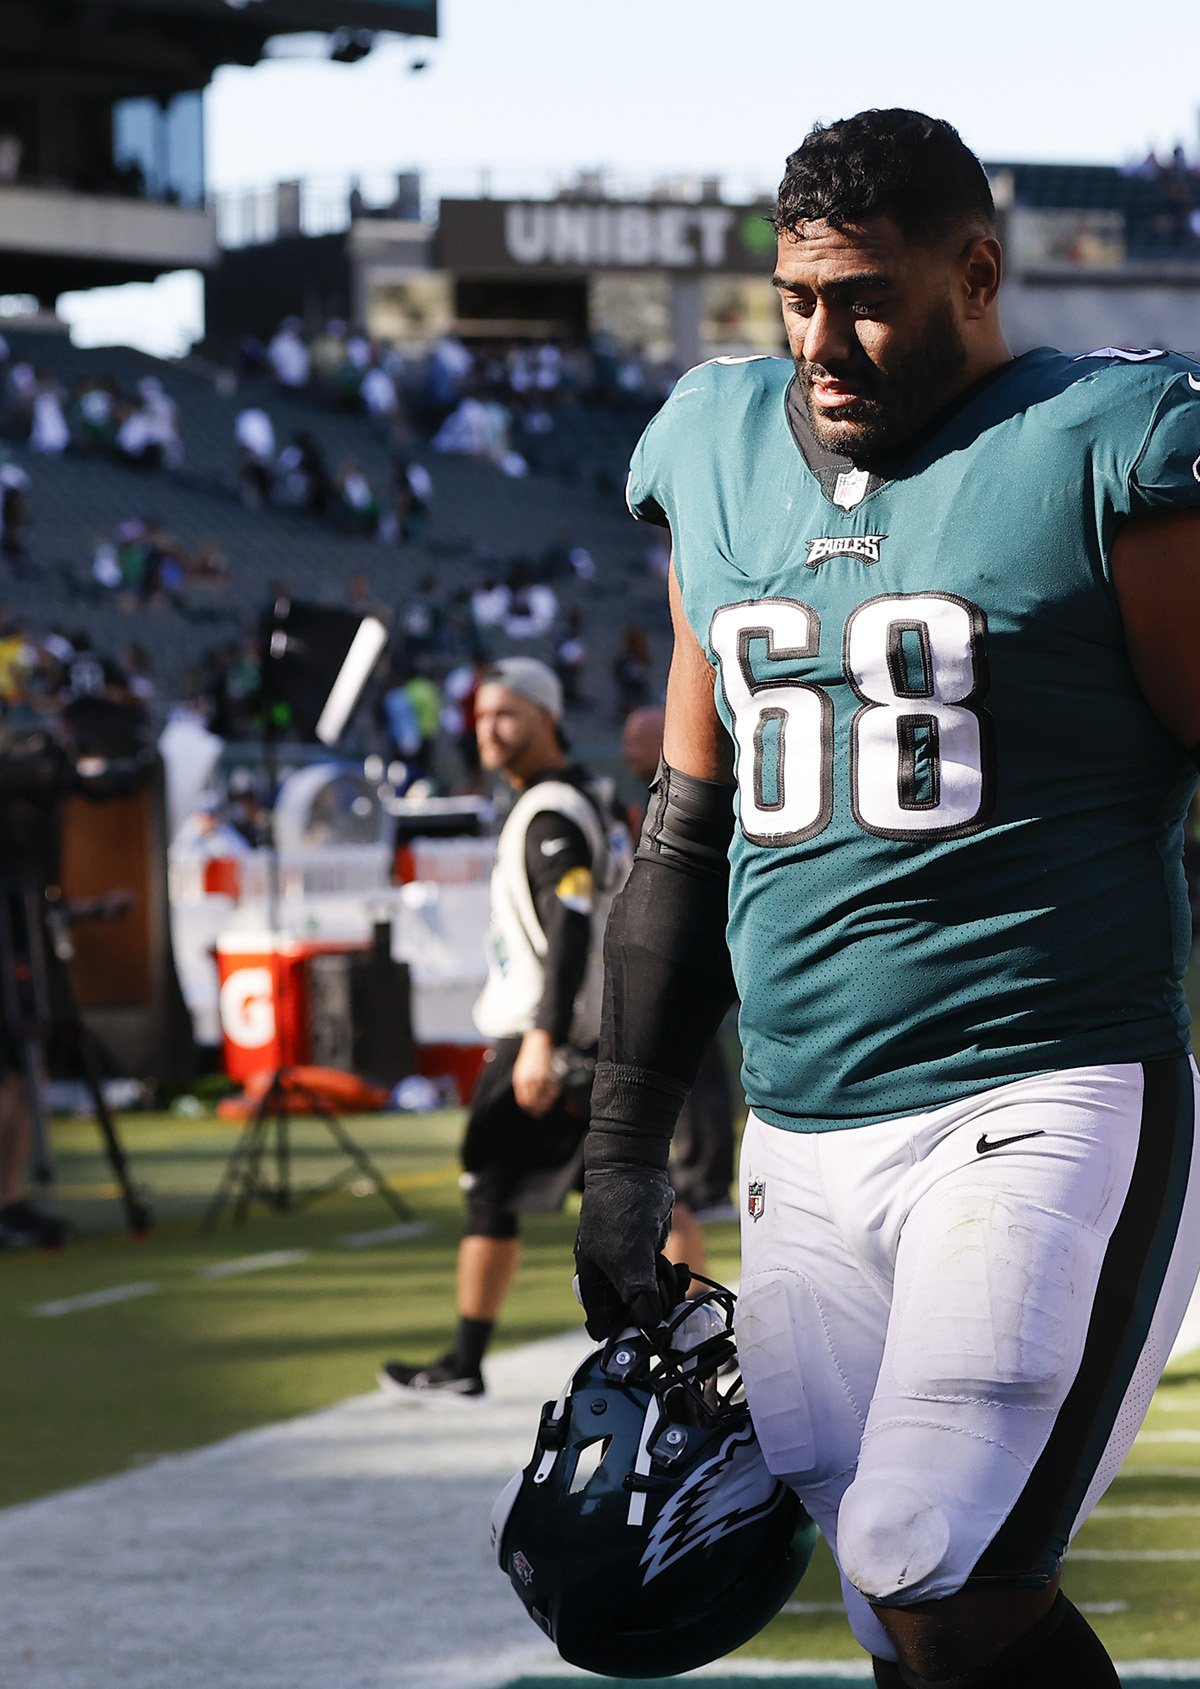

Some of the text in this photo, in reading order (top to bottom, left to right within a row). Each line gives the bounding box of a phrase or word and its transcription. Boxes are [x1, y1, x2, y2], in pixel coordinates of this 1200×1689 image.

[505, 204, 734, 267] UNIBET
[805, 535, 885, 564] EAGLES
[710, 591, 994, 847] 68
[220, 967, 276, 1049] G
